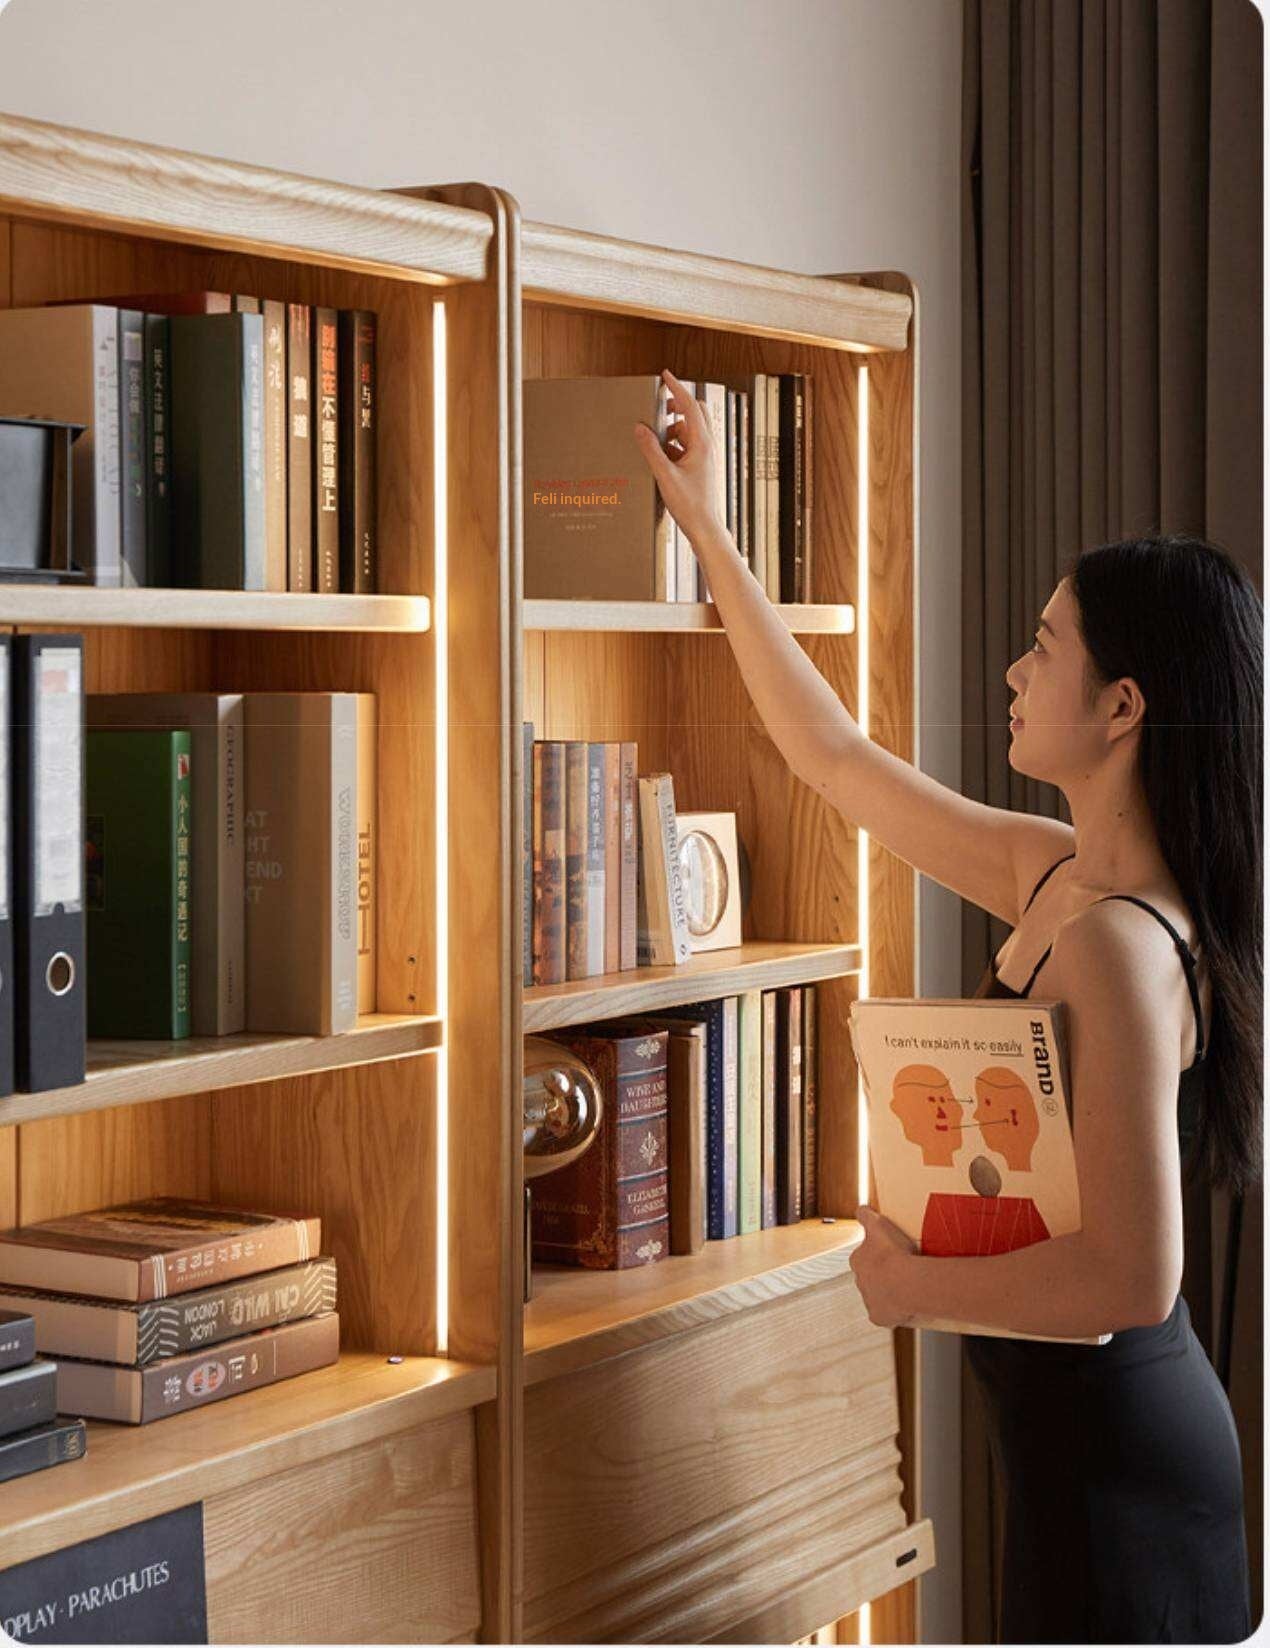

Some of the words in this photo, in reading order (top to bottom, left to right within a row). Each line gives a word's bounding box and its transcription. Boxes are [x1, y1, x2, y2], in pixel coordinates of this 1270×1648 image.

[891, 1035, 919, 1048] can't
[920, 1036, 961, 1052] explain
[961, 1036, 971, 1050] it
[973, 1040, 987, 1051] so
[989, 1038, 1023, 1054] easily
[68, 1560, 170, 1619] PARACHUTES
